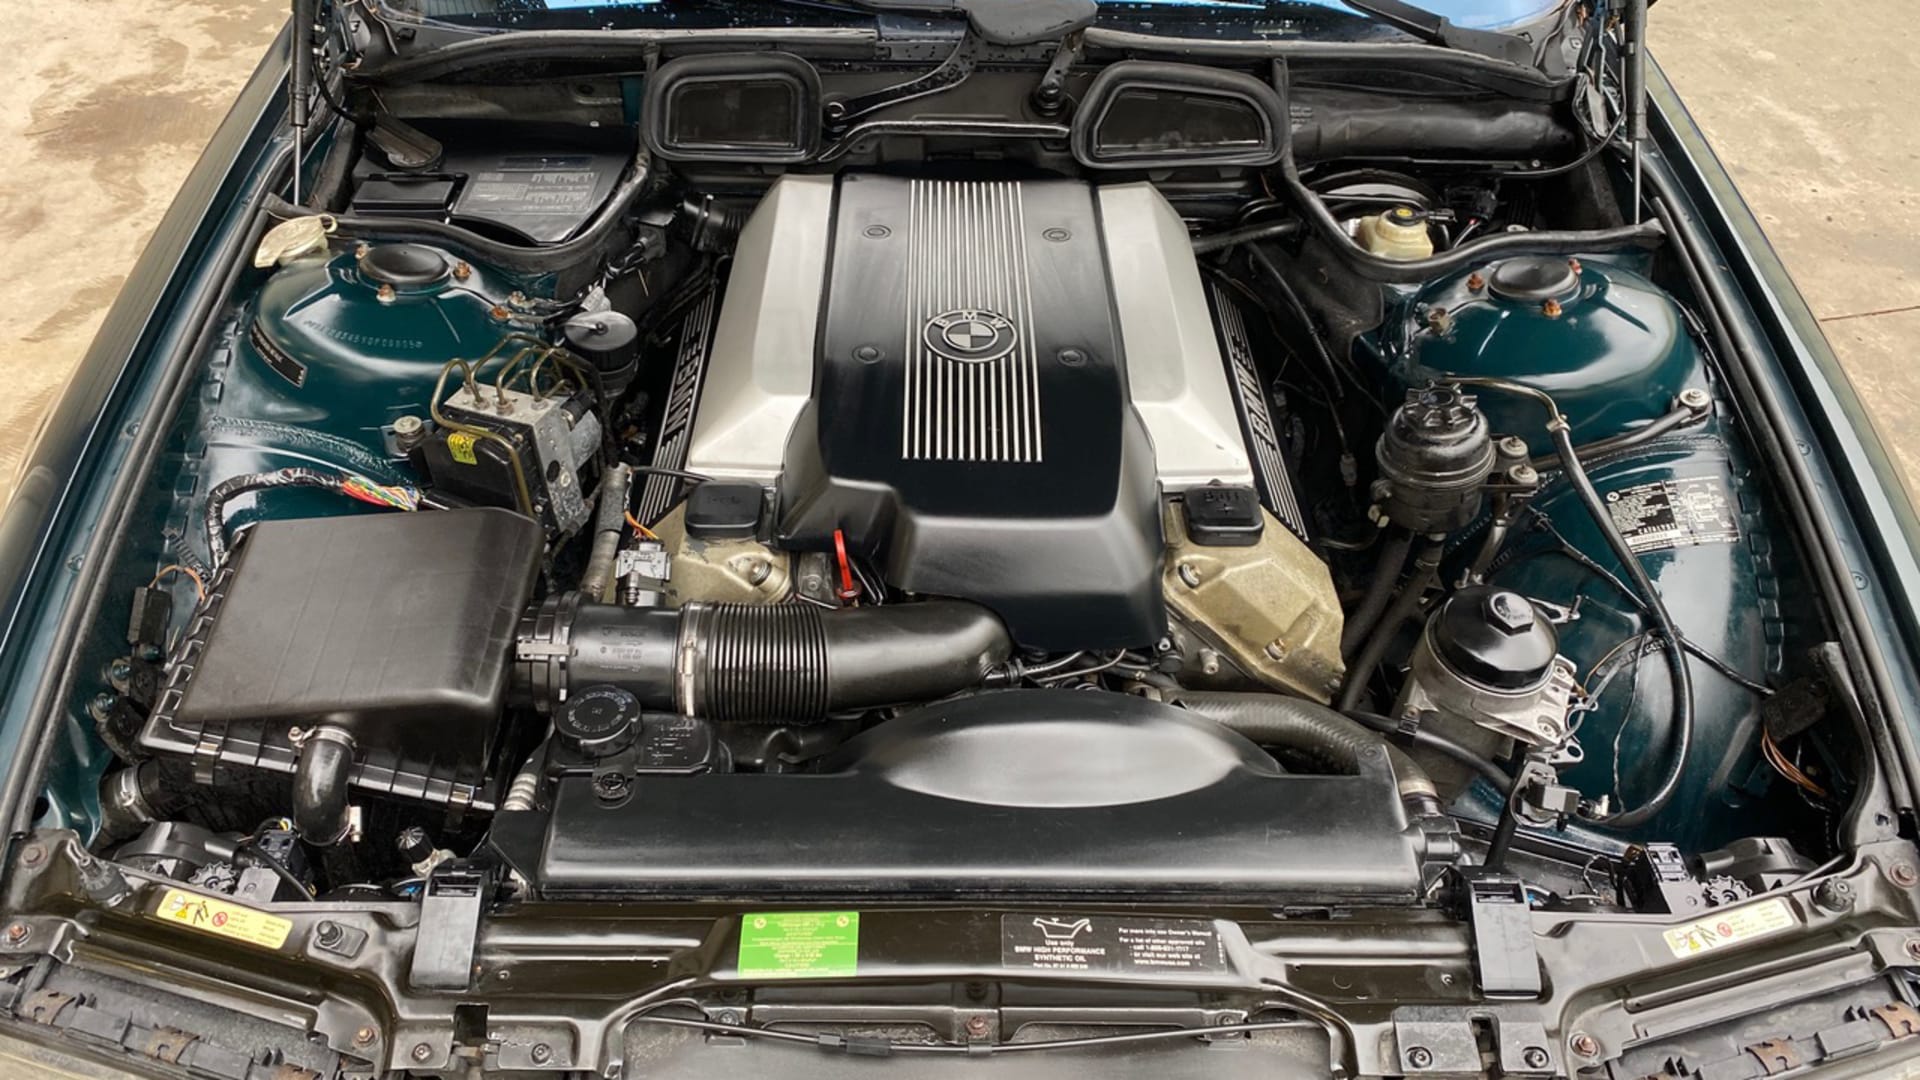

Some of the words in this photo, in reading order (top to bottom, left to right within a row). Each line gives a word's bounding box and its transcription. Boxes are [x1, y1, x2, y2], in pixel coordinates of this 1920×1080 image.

[932, 310, 1008, 330] BMW
[664, 355, 700, 435] BMW
[1234, 358, 1274, 445] BMW
[1034, 954, 1073, 962] SYNTHETIC
[1052, 946, 1105, 955] PERFORMANCE
